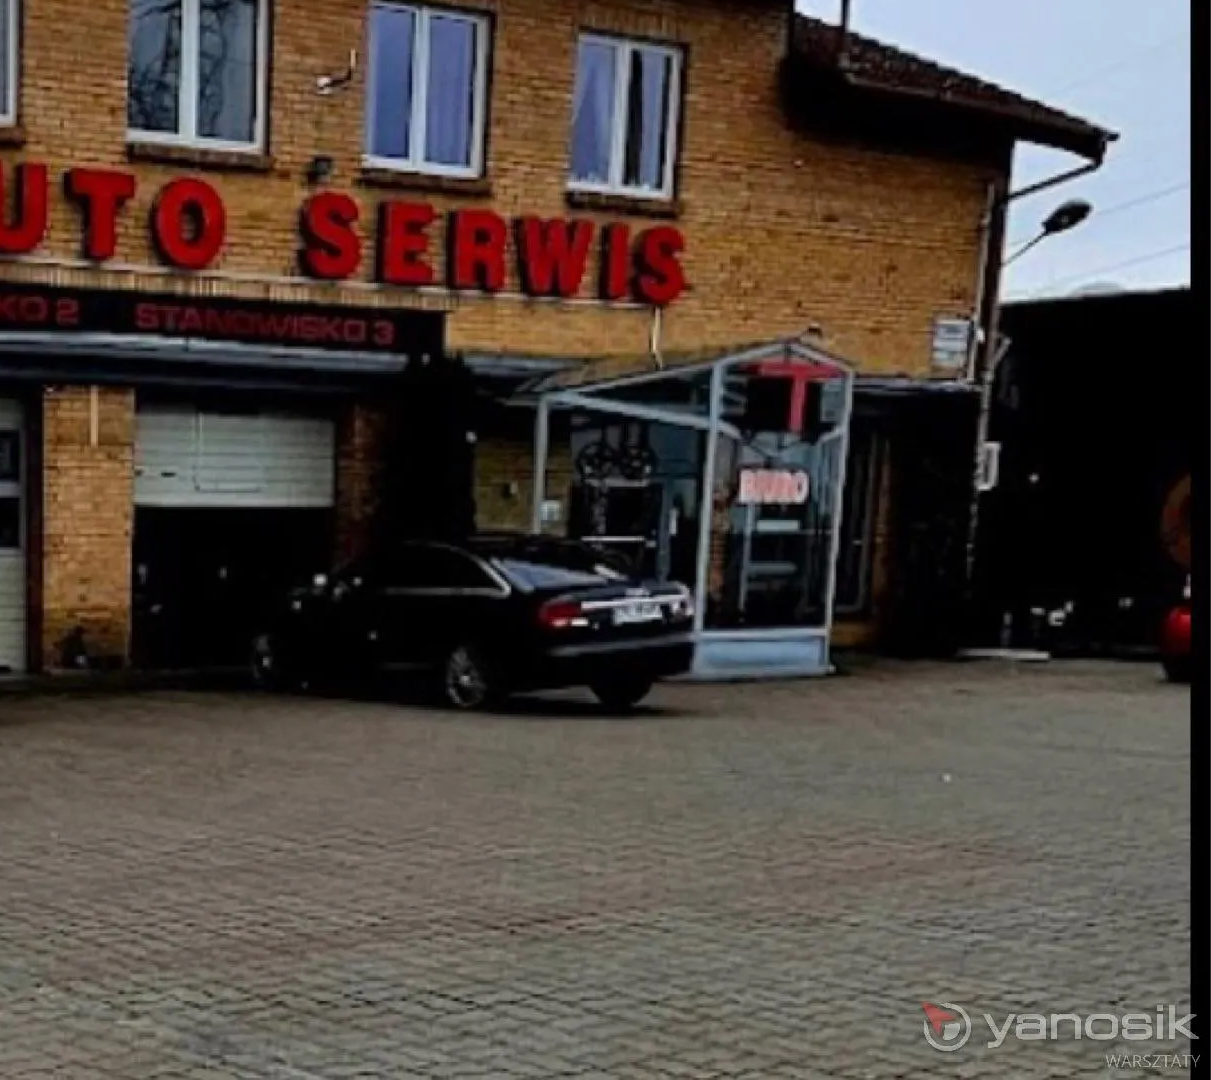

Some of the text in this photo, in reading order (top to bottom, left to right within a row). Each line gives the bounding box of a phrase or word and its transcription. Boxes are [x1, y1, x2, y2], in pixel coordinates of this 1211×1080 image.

[300, 189, 688, 306] SERWIS
[55, 297, 80, 325] 2
[134, 302, 396, 345] STANOWISKO 3
